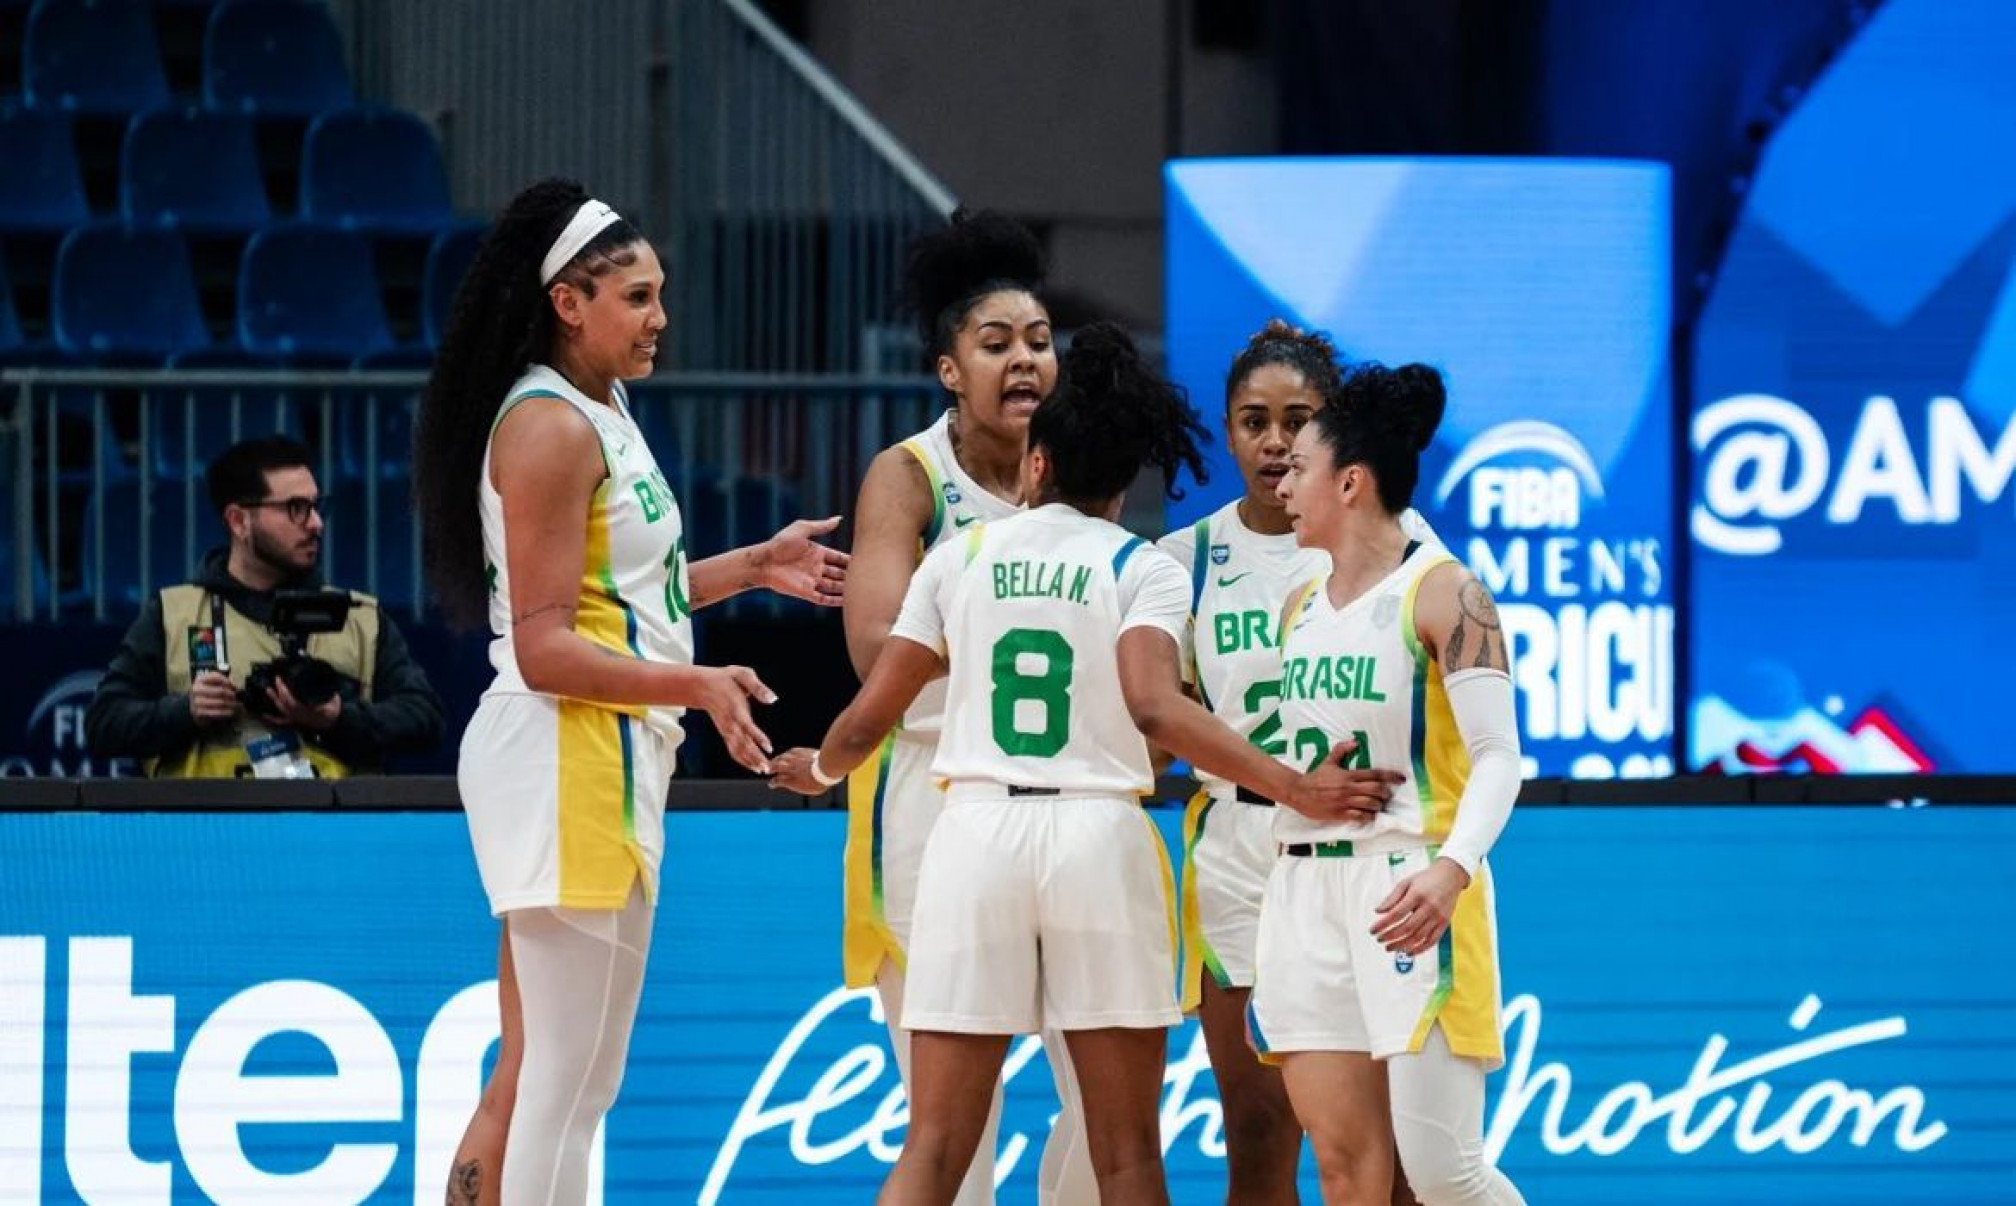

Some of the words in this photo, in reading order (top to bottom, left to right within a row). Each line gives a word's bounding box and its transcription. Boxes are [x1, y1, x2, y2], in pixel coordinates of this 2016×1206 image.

[1468, 466, 1580, 530] FIBA
[993, 560, 1066, 600] BELLA
[1067, 564, 1092, 606] N.
[991, 627, 1074, 758] 8
